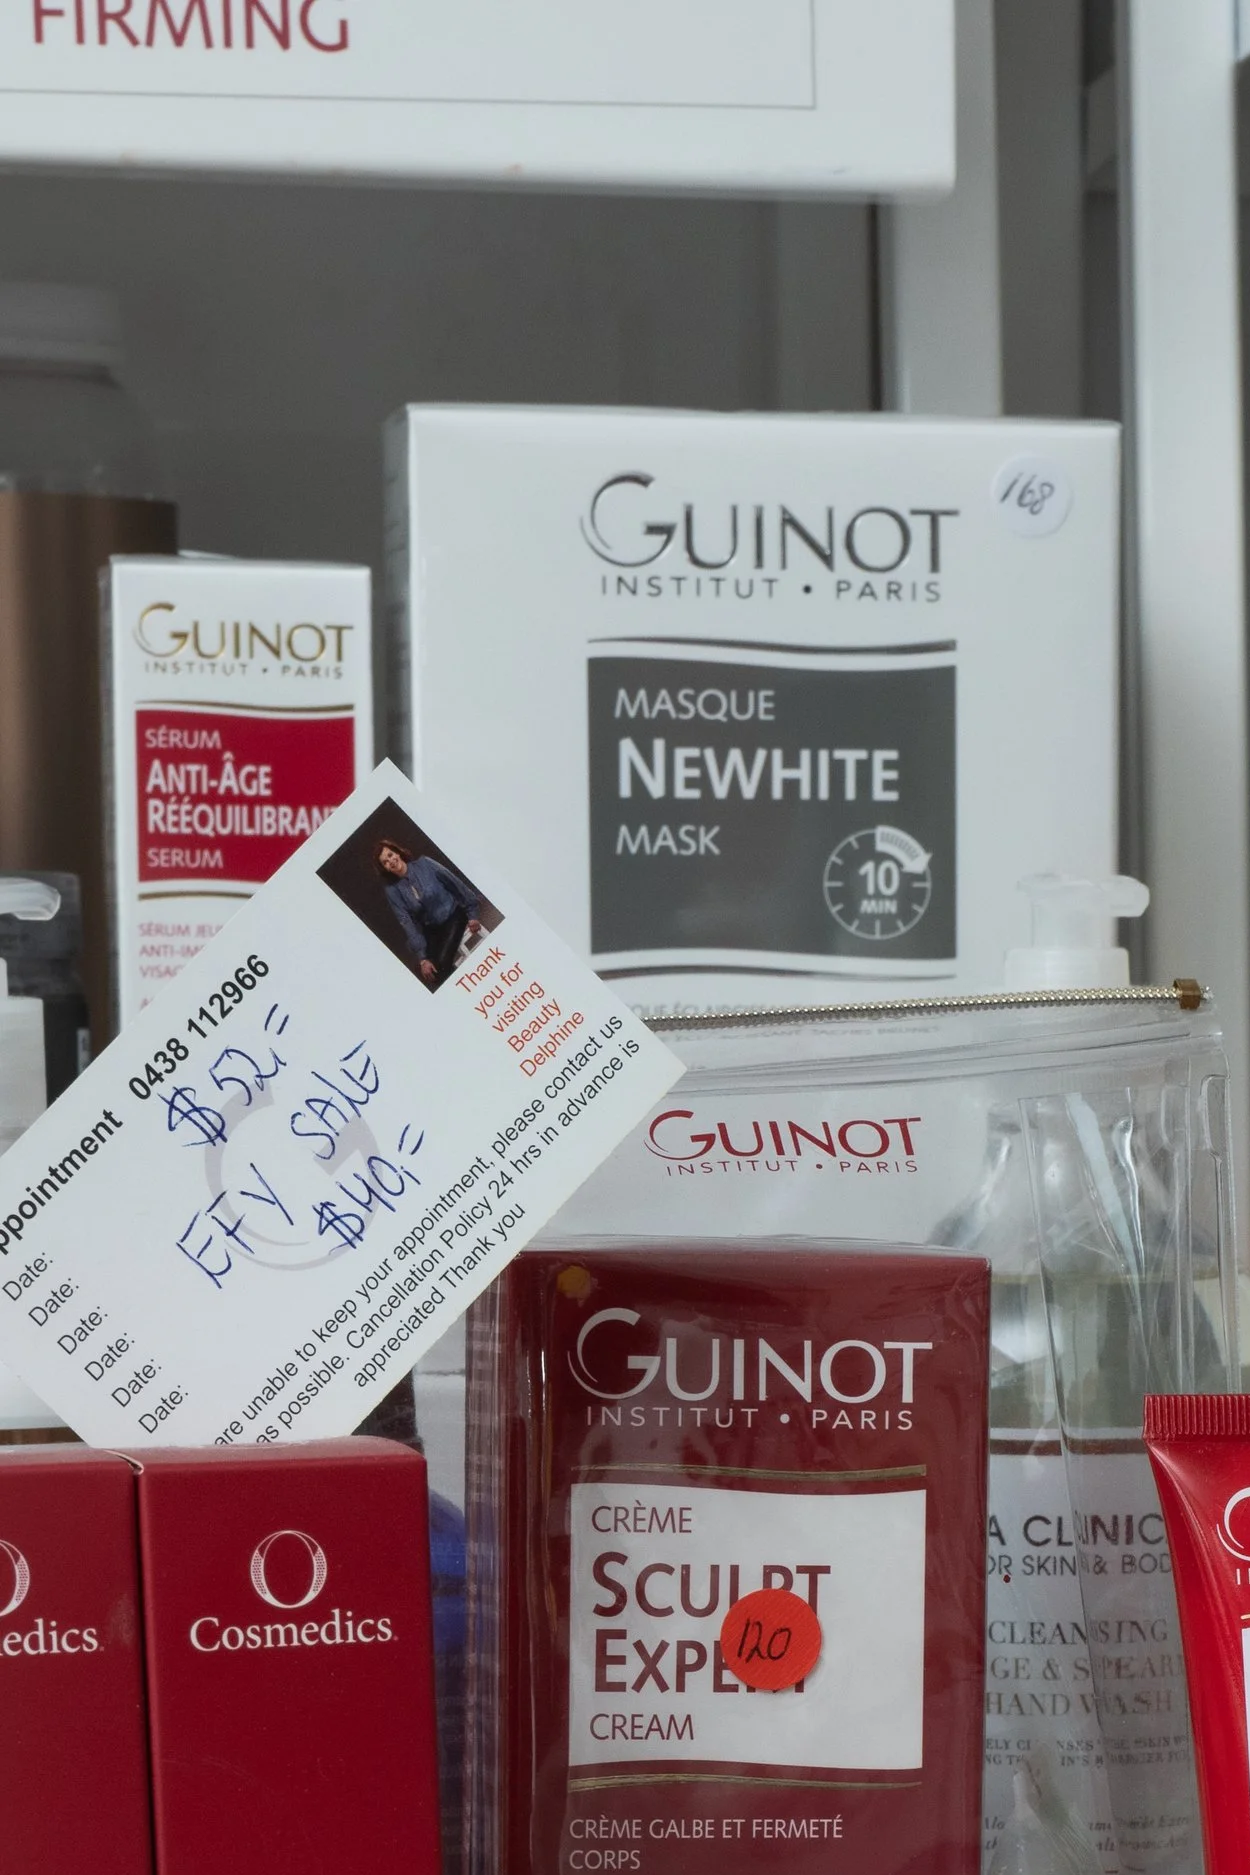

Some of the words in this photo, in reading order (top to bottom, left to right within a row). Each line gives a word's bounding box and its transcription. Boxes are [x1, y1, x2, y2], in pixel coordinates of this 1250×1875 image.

[33, 0, 349, 52] FIRMING
[580, 470, 960, 574] GUINOT
[601, 575, 779, 599] INSTITUT
[836, 580, 942, 603] PARIS
[133, 602, 354, 663] GUINOT
[614, 688, 776, 722] MASQUE
[145, 724, 222, 750] SÉRUM
[145, 752, 272, 797] ANTI-ÂGE
[617, 736, 900, 801] NEWHITE
[146, 847, 224, 869] SERUM
[616, 824, 721, 857] MASK
[858, 860, 901, 896] 10
[860, 898, 898, 916] MIN
[454, 946, 506, 993] Thank
[473, 984, 505, 1019] you
[499, 961, 523, 987] for
[128, 1036, 189, 1100] 0438
[186, 953, 269, 1039] 112966
[491, 981, 545, 1032] visiting
[506, 997, 561, 1053] Beauty
[518, 1011, 584, 1077] Delphine
[643, 1110, 921, 1161] GUINOT
[213, 1420, 244, 1454] are
[241, 1361, 299, 1421] unable
[293, 1341, 317, 1362] to
[310, 1298, 357, 1344] keep
[354, 1257, 393, 1304] your
[392, 1155, 495, 1261] appointment,
[490, 1098, 545, 1159] please
[543, 1035, 603, 1099] contact
[598, 1015, 623, 1039] us
[276, 1354, 350, 1430] possible.
[345, 1248, 445, 1349] Cancellation
[438, 1195, 493, 1250] Policy
[487, 1169, 514, 1199] 24
[508, 1143, 542, 1174] hrs
[535, 1125, 560, 1146] in
[556, 1056, 624, 1127] advance
[617, 1038, 640, 1058] is
[0, 1251, 53, 1301] Date:
[353, 1284, 446, 1387] appreciated
[437, 1235, 496, 1288] Thank
[491, 1202, 526, 1242] you
[27, 1277, 79, 1327] Date:
[56, 1305, 108, 1355] Date:
[83, 1331, 135, 1382] Date:
[568, 1307, 933, 1405] GUINOT
[110, 1358, 162, 1408] Date:
[136, 1384, 188, 1434] Date:
[586, 1406, 759, 1429] INSTITUT
[812, 1408, 914, 1432] PARIS
[591, 1500, 693, 1534] CRÈME
[190, 1609, 394, 1653] Cosmedics
[736, 1617, 791, 1664] 120
[590, 1713, 695, 1741] CREAM
[569, 1815, 642, 1839] CRÈME
[649, 1819, 715, 1839] GALBE
[722, 1819, 746, 1839] ET
[752, 1814, 843, 1839] FERMETÉ
[569, 1850, 641, 1871] CORPS
